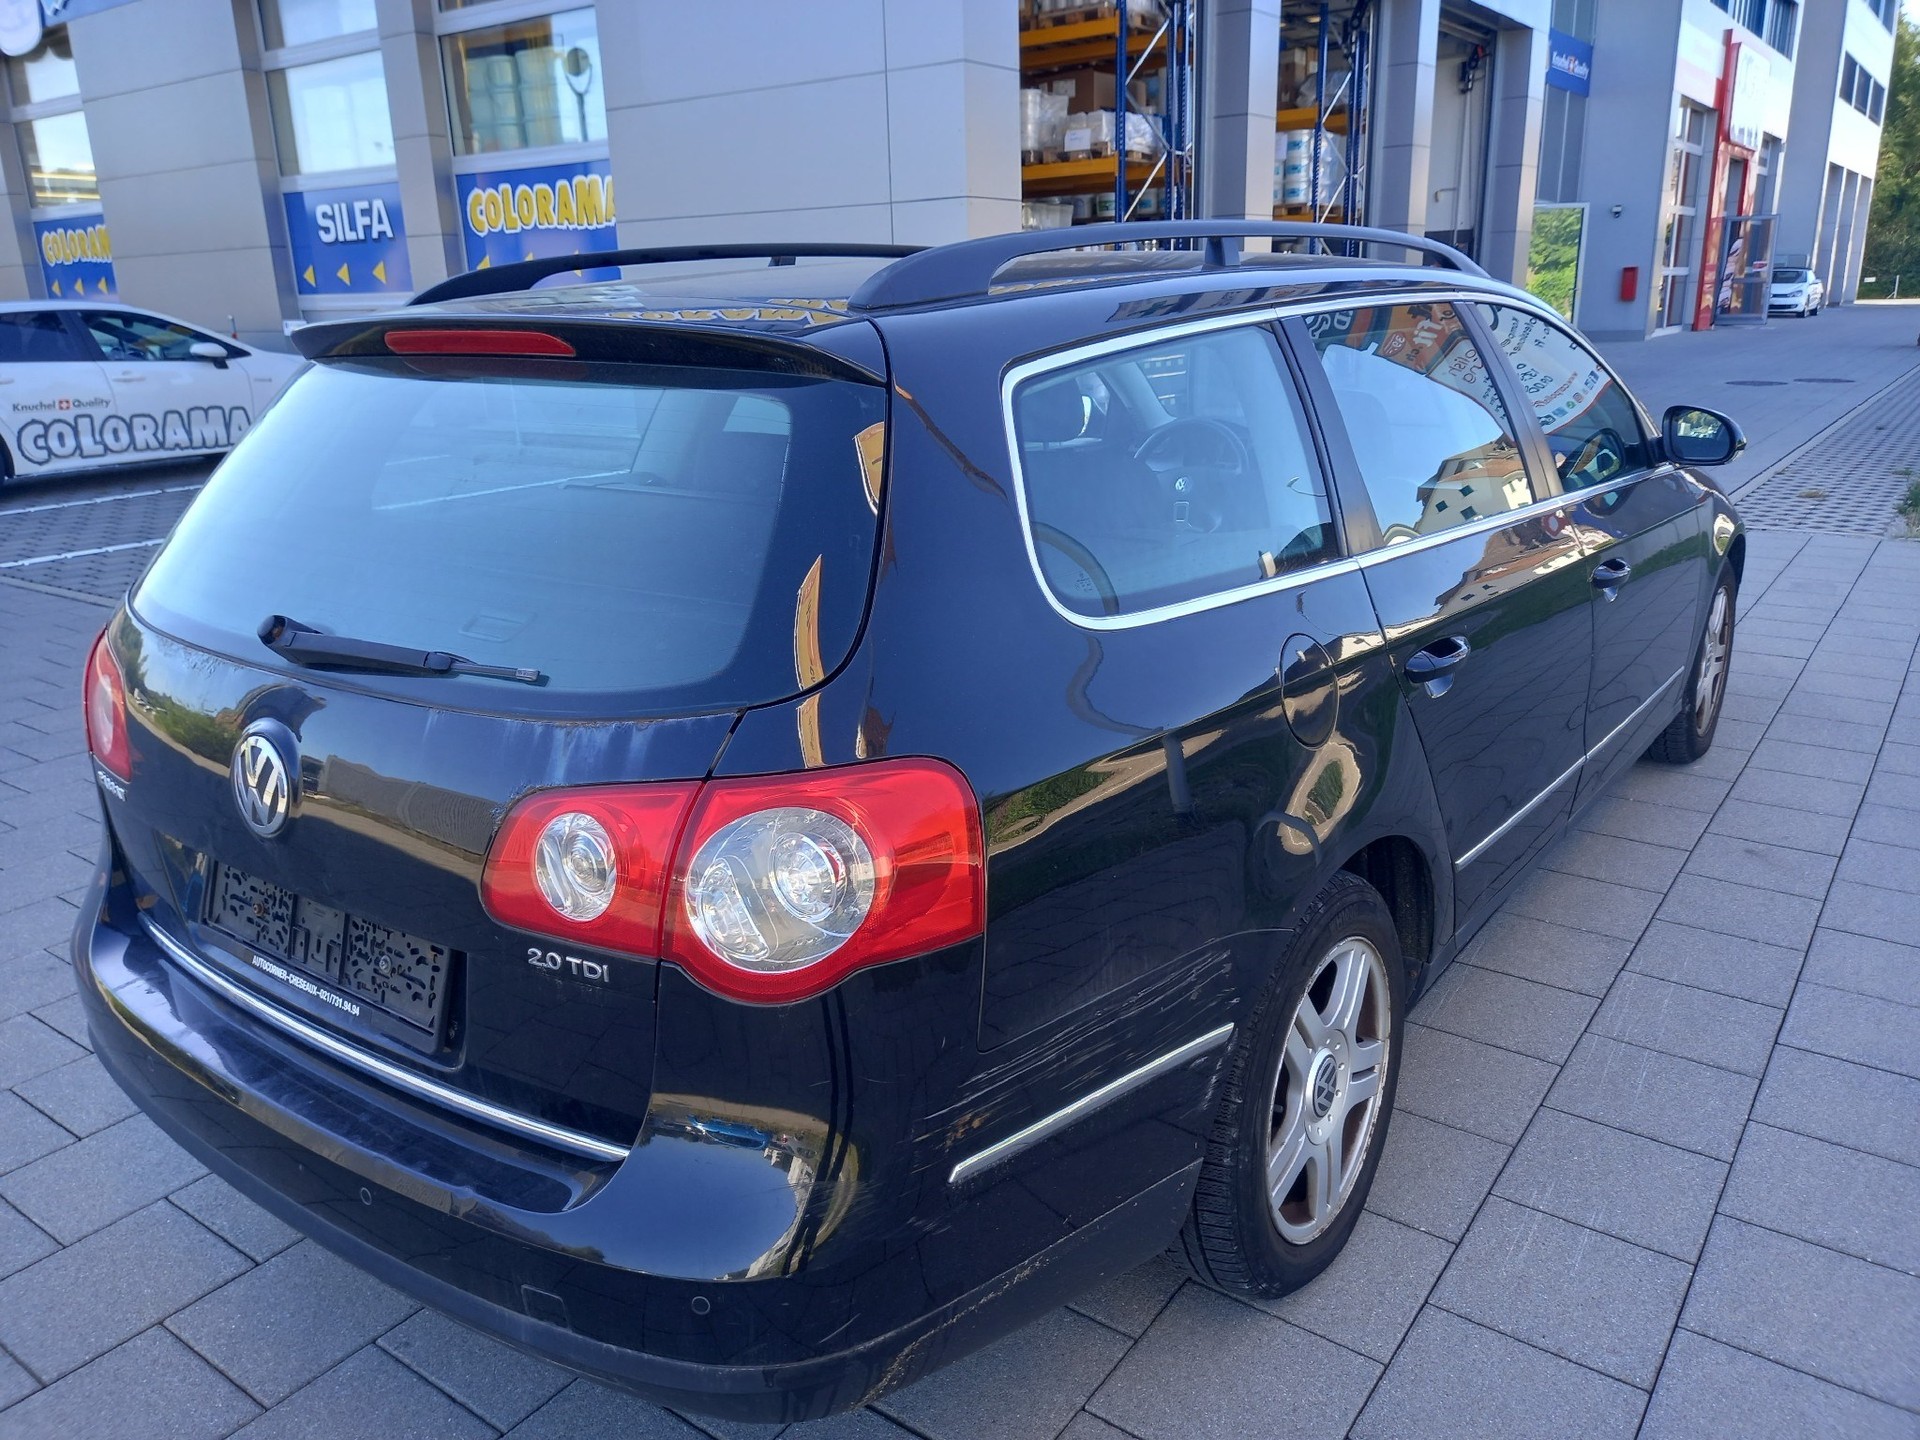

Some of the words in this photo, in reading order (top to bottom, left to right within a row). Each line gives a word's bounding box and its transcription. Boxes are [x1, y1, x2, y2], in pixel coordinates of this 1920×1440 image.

[315, 199, 395, 244] SILFA
[42, 224, 112, 267] COLORAM
[12, 401, 57, 412] Knuchel
[72, 397, 111, 409] Quality
[17, 406, 252, 465] COLORAMA
[565, 955, 610, 983] TDI
